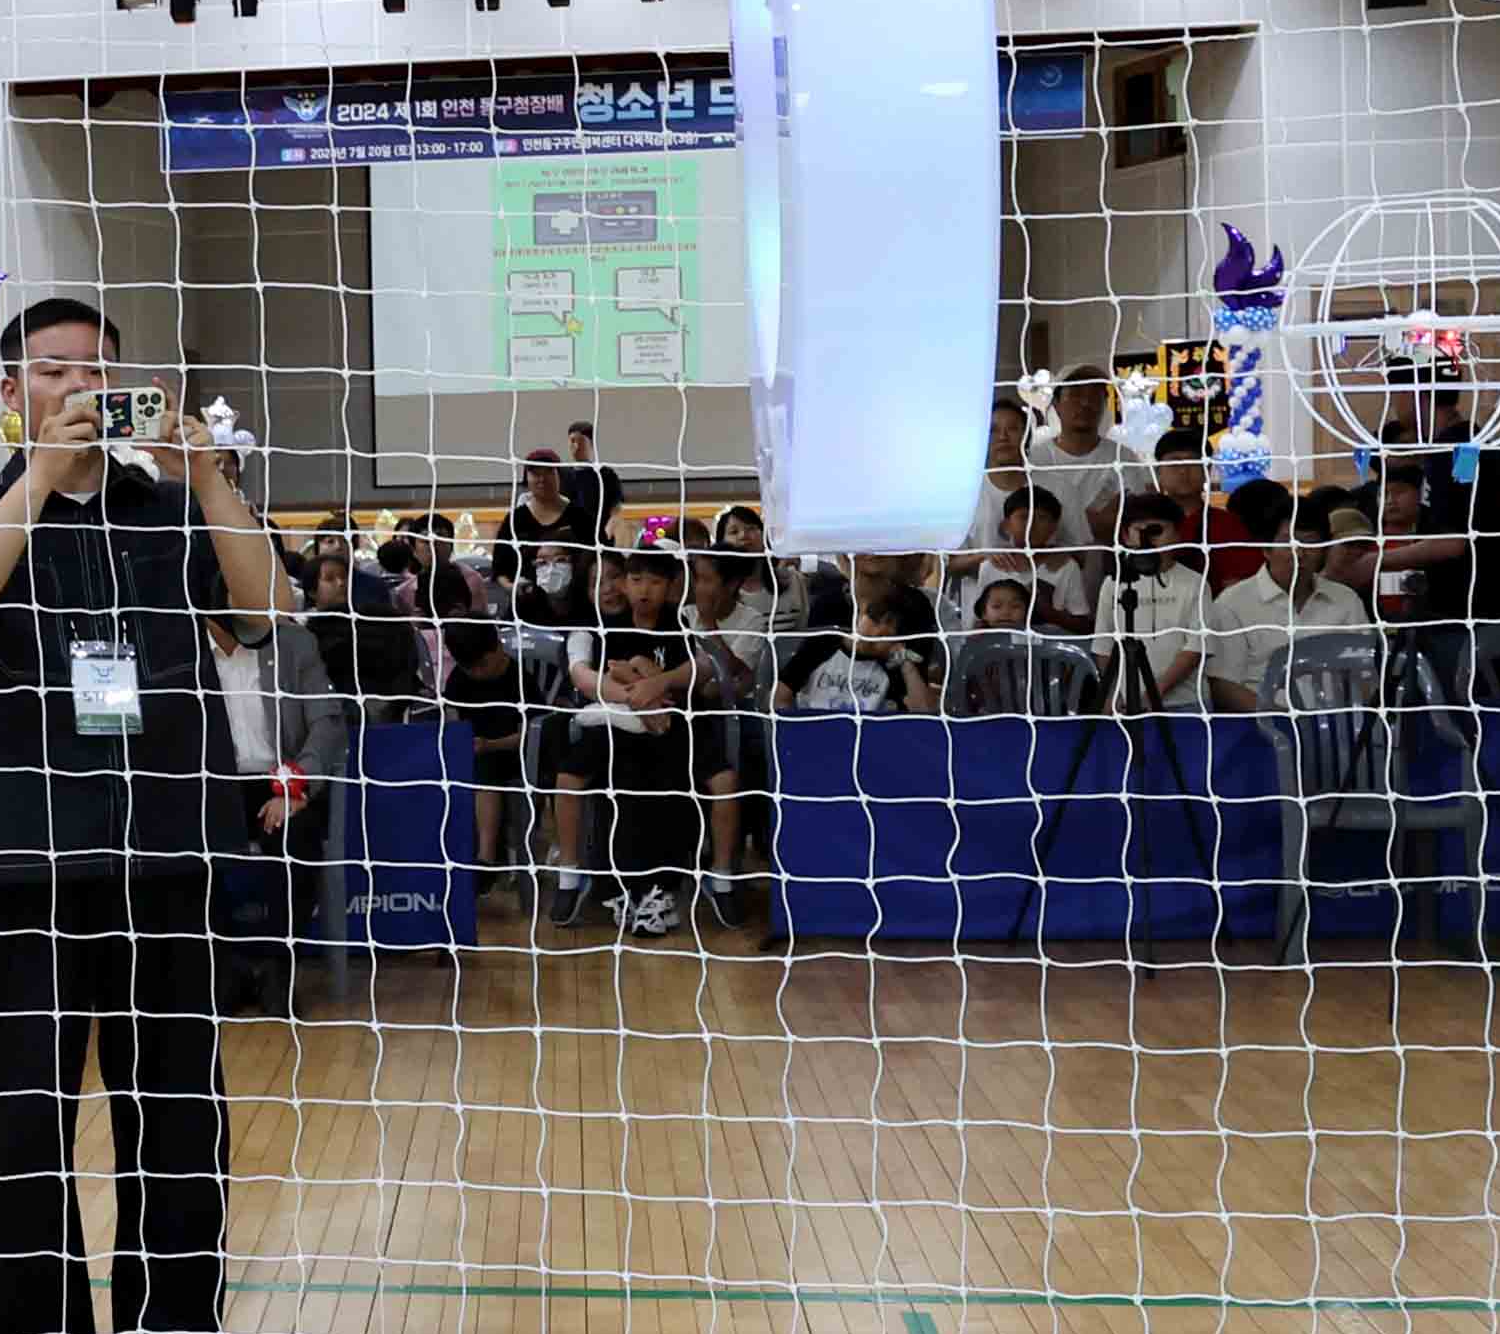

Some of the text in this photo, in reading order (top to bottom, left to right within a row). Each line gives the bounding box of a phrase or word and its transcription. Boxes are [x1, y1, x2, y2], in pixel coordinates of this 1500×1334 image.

[337, 102, 390, 122] 2024
[441, 97, 475, 118] 인천
[577, 79, 695, 123] 청소년
[310, 146, 347, 160] 202년
[417, 142, 446, 155] 13:00
[454, 141, 484, 154] 17:00
